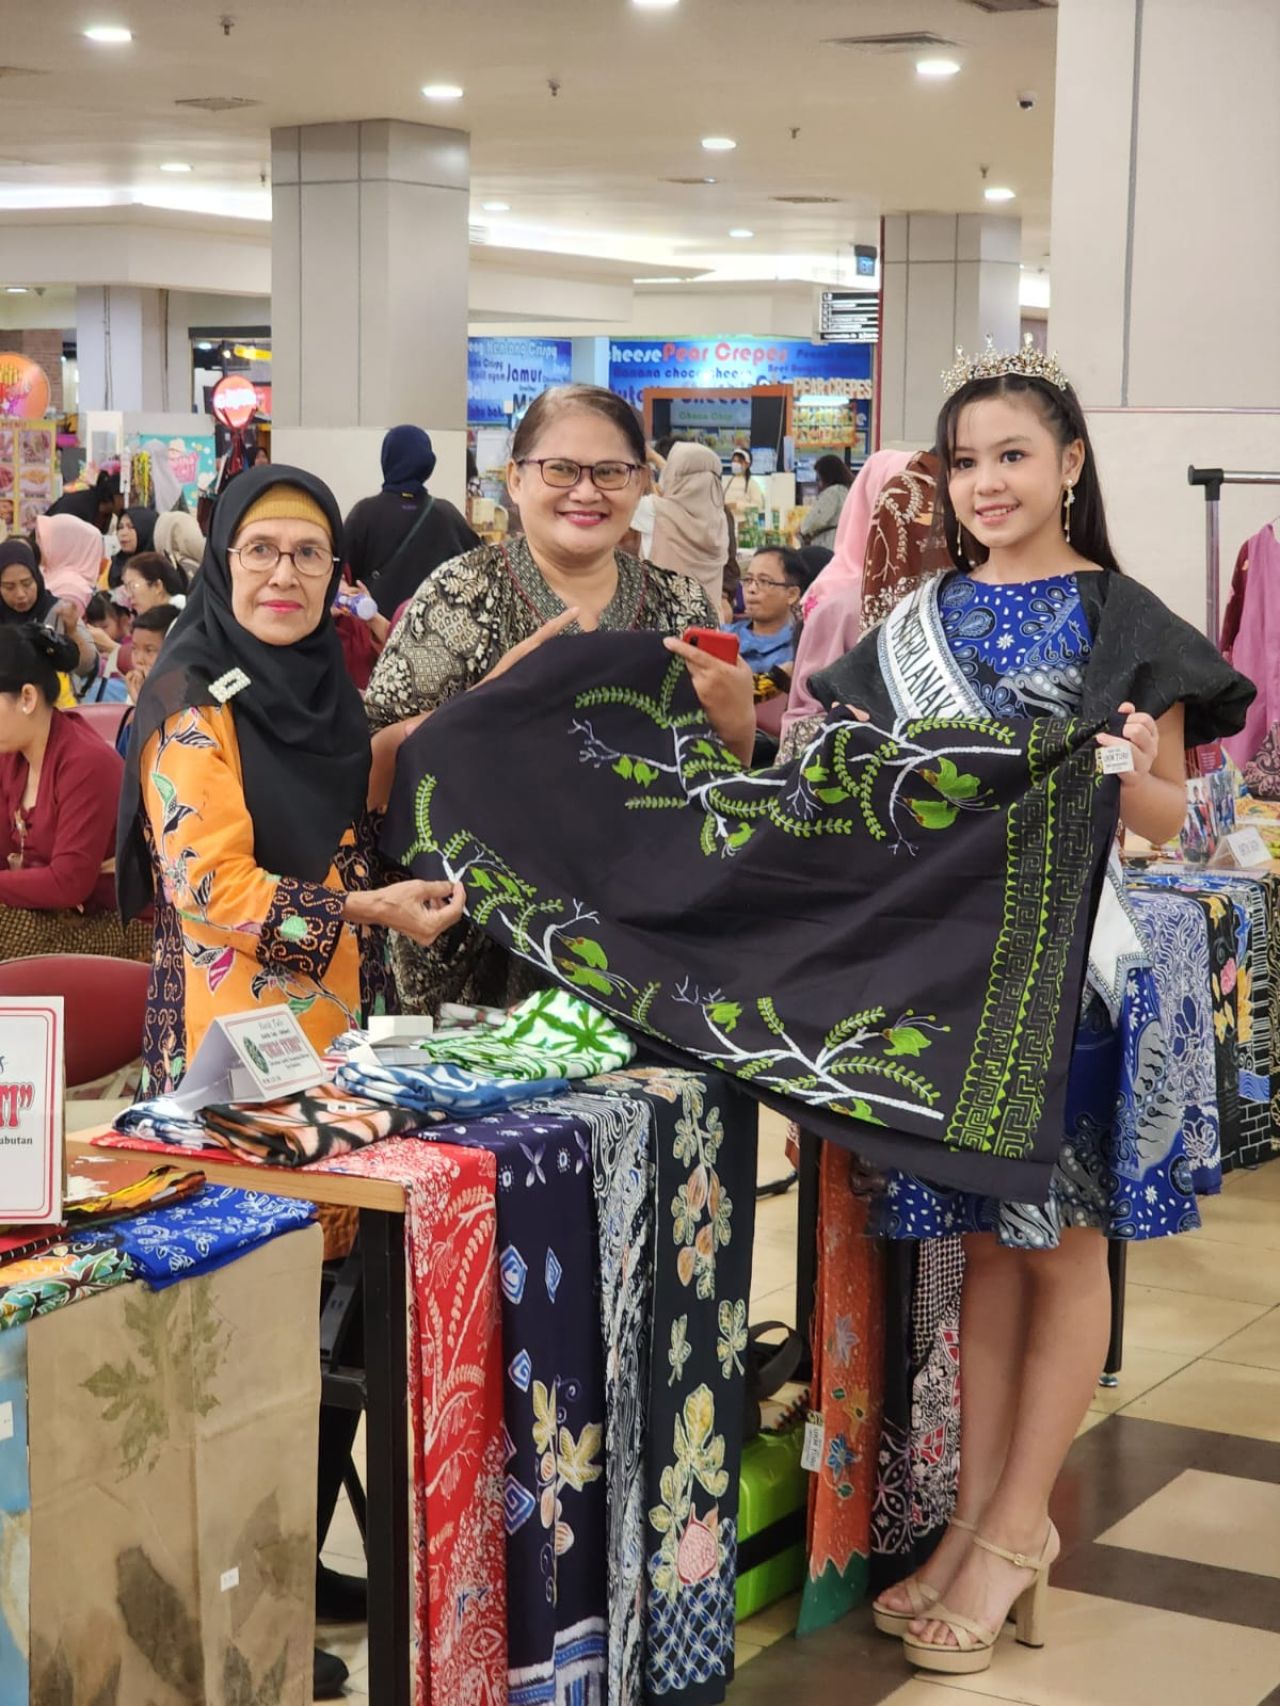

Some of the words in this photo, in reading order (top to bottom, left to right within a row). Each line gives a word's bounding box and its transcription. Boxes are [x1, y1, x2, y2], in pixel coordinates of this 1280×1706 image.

[662, 342, 709, 363] Pear
[715, 342, 787, 366] Crepes
[507, 363, 543, 383] Jamur
[904, 659, 958, 722] ANAK
